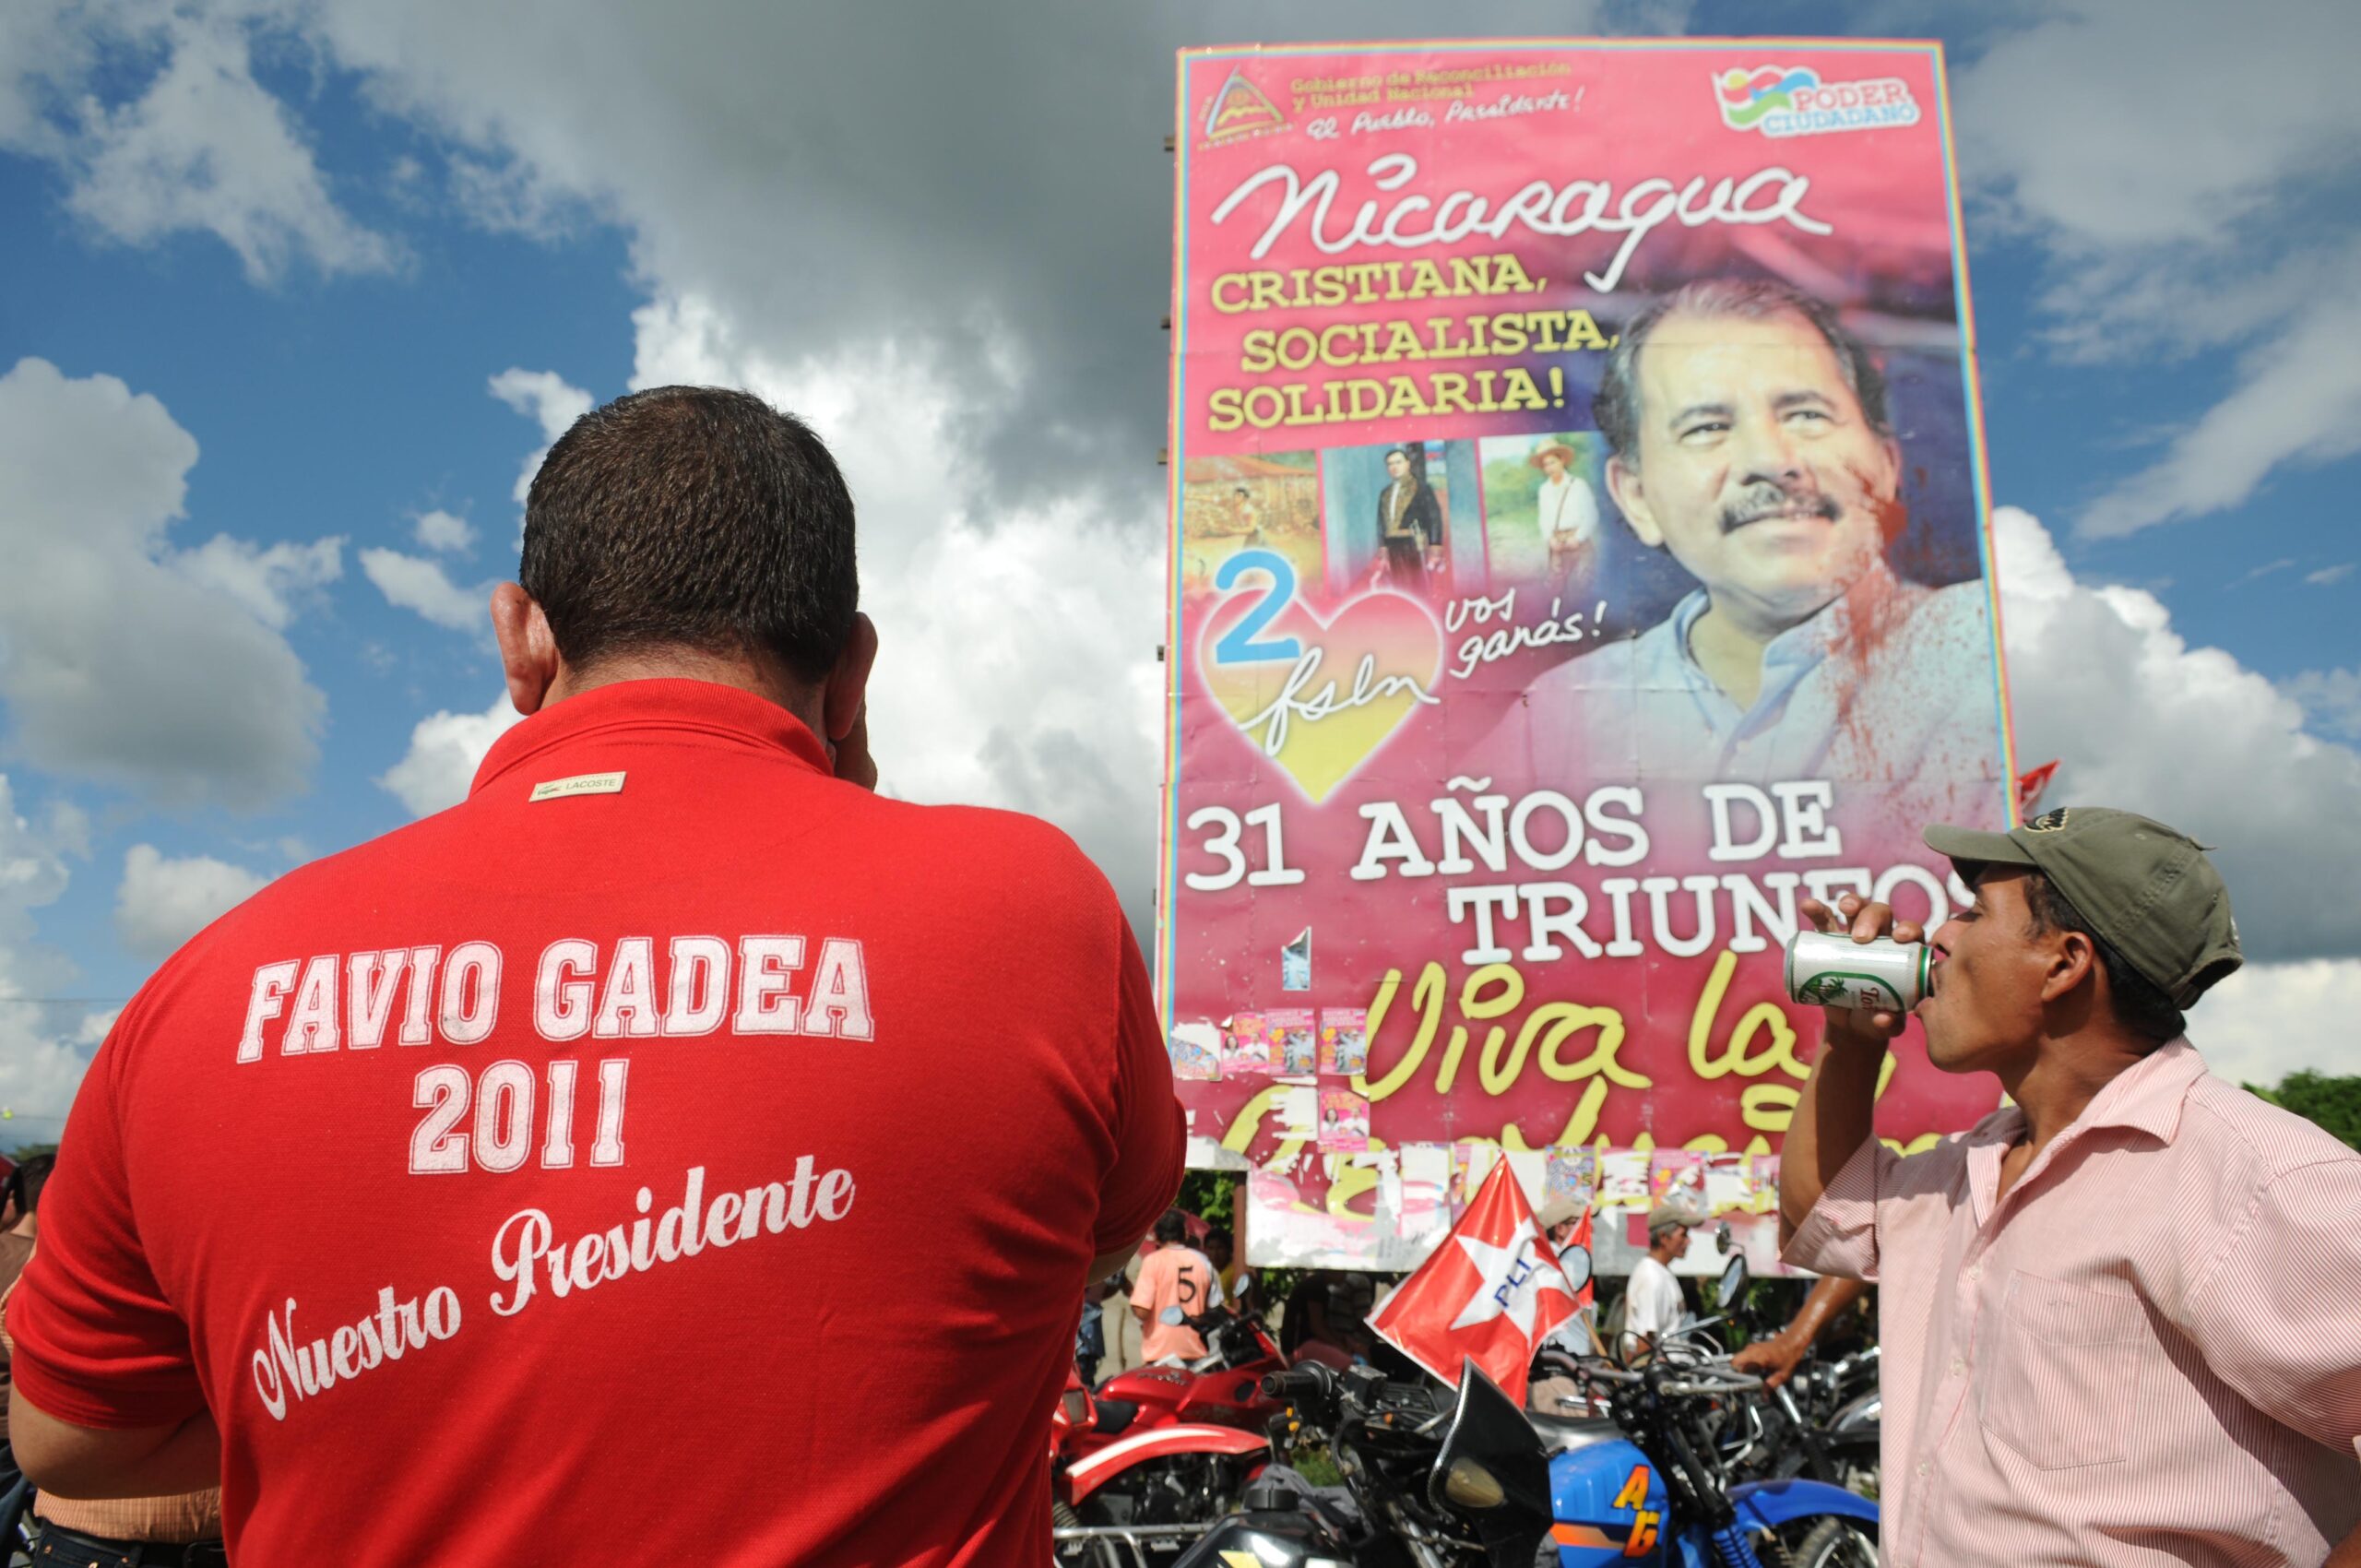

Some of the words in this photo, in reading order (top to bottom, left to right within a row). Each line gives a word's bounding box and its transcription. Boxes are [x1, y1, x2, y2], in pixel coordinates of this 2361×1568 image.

[1290, 76, 1382, 93] Gobierno
[1386, 70, 1411, 87] de
[1415, 62, 1571, 86] Reconciliación
[1293, 96, 1305, 113] y
[1311, 89, 1381, 109] Unidad
[1386, 82, 1473, 102] Nacional
[1794, 81, 1907, 112] PODER
[1306, 116, 1340, 140] El
[1350, 106, 1435, 136] Pueblo,
[1444, 84, 1585, 124] Presidente!
[1762, 103, 1916, 135] CIUDADANO
[1211, 153, 1833, 293] Nicaragua
[1211, 253, 1548, 314] CRISTIANA,
[1240, 309, 1620, 373] SOCIALISTA,
[1208, 366, 1565, 433] SOLIDARIA!
[1215, 549, 1301, 664] 2
[1444, 588, 1515, 633] vos
[1449, 598, 1608, 679] ganás!
[1238, 646, 1441, 756] fsln
[566, 778, 616, 790] LACOSTE
[1184, 801, 1306, 892] 31
[1350, 776, 1650, 880] AÑOS
[1703, 779, 1843, 861] DE
[236, 944, 504, 1063] FAVIO
[533, 934, 874, 1041] GADEA
[1351, 961, 1653, 1102] Viva
[1688, 949, 1812, 1080] la
[409, 1058, 630, 1175] 2011
[253, 1285, 462, 1420] Nuestro
[490, 1155, 856, 1316] Presidente
[1178, 1265, 1197, 1303] 5
[1494, 1258, 1531, 1307] PLI
